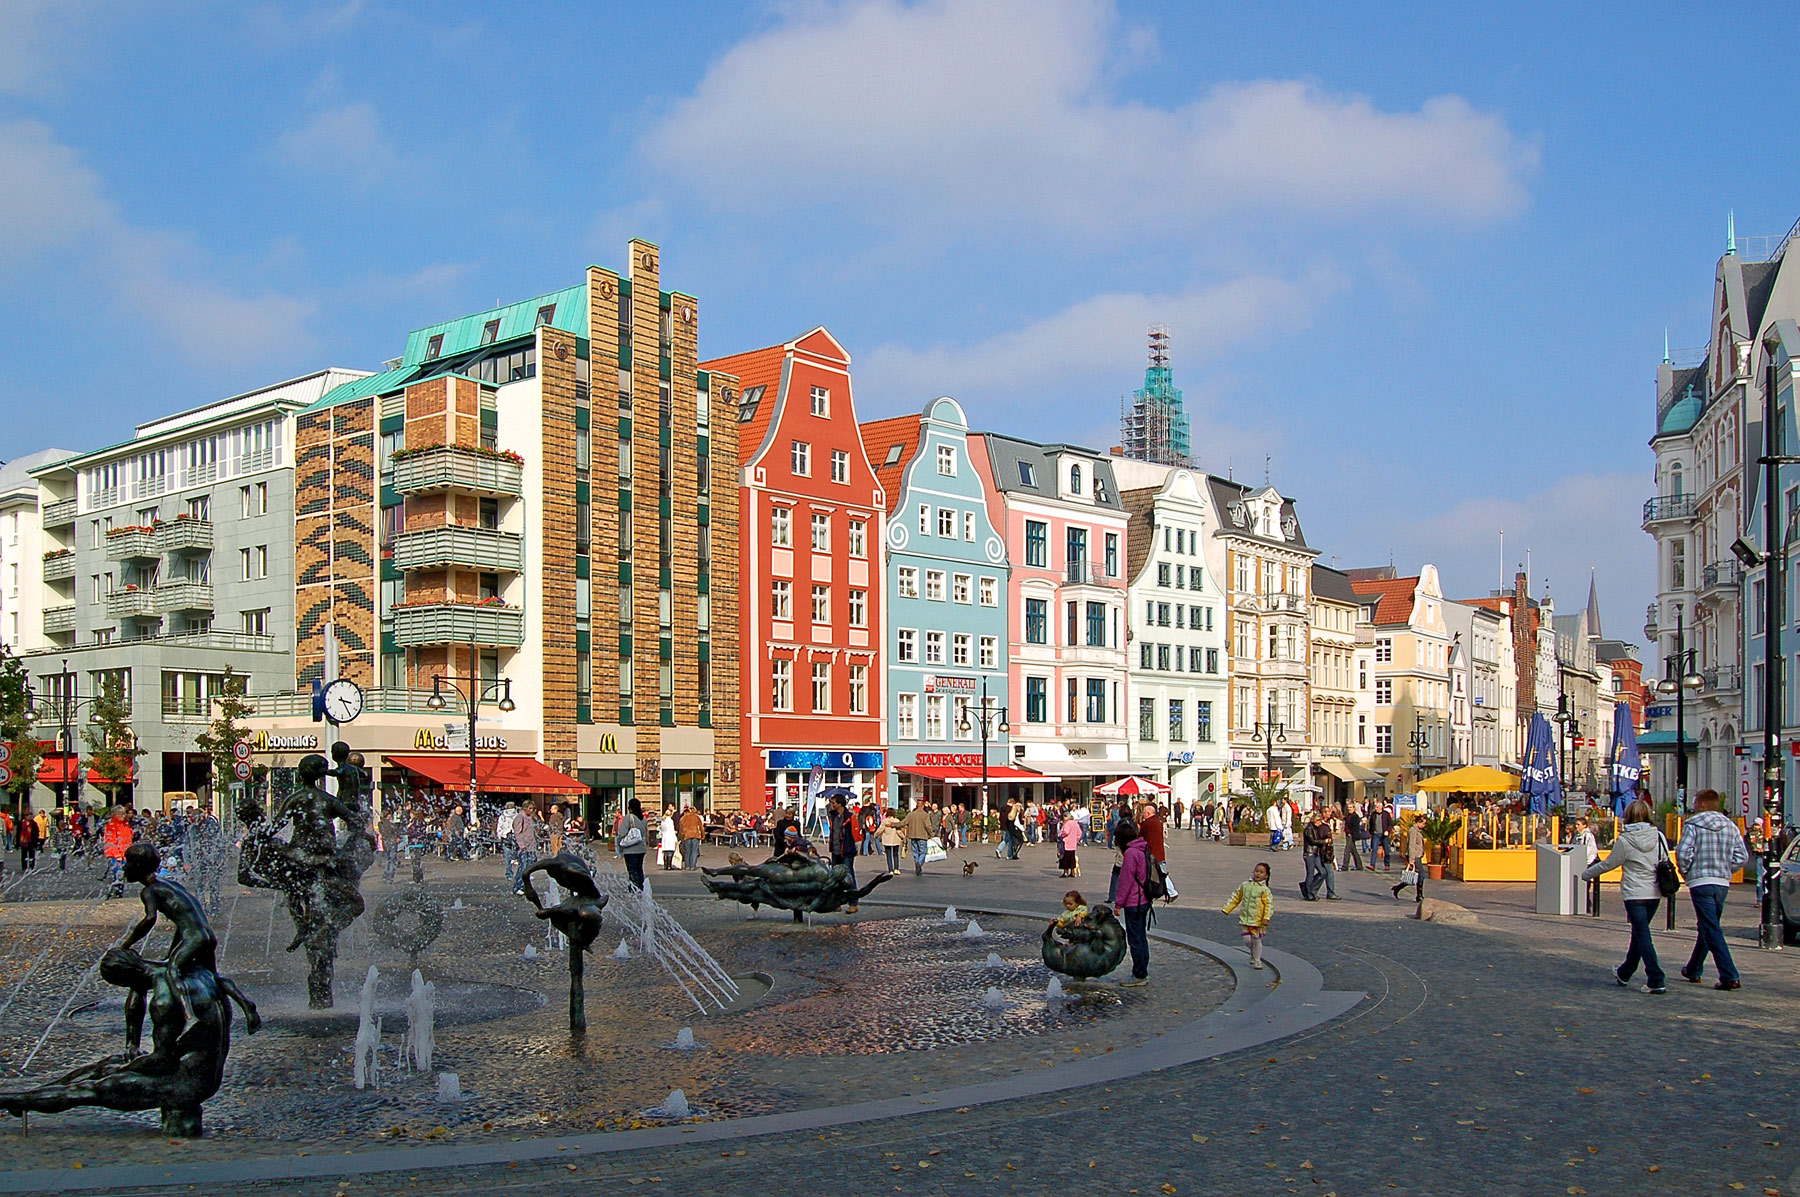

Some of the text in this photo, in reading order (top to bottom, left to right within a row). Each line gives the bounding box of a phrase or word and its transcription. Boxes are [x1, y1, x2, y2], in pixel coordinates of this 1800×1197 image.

[935, 677, 977, 689] GENERALI
[255, 730, 318, 750] McDonald's
[415, 728, 508, 748] Mcald's
[842, 753, 854, 768] O2
[916, 753, 985, 765] STADTBÄCKERE
[812, 772, 823, 790] DSL
